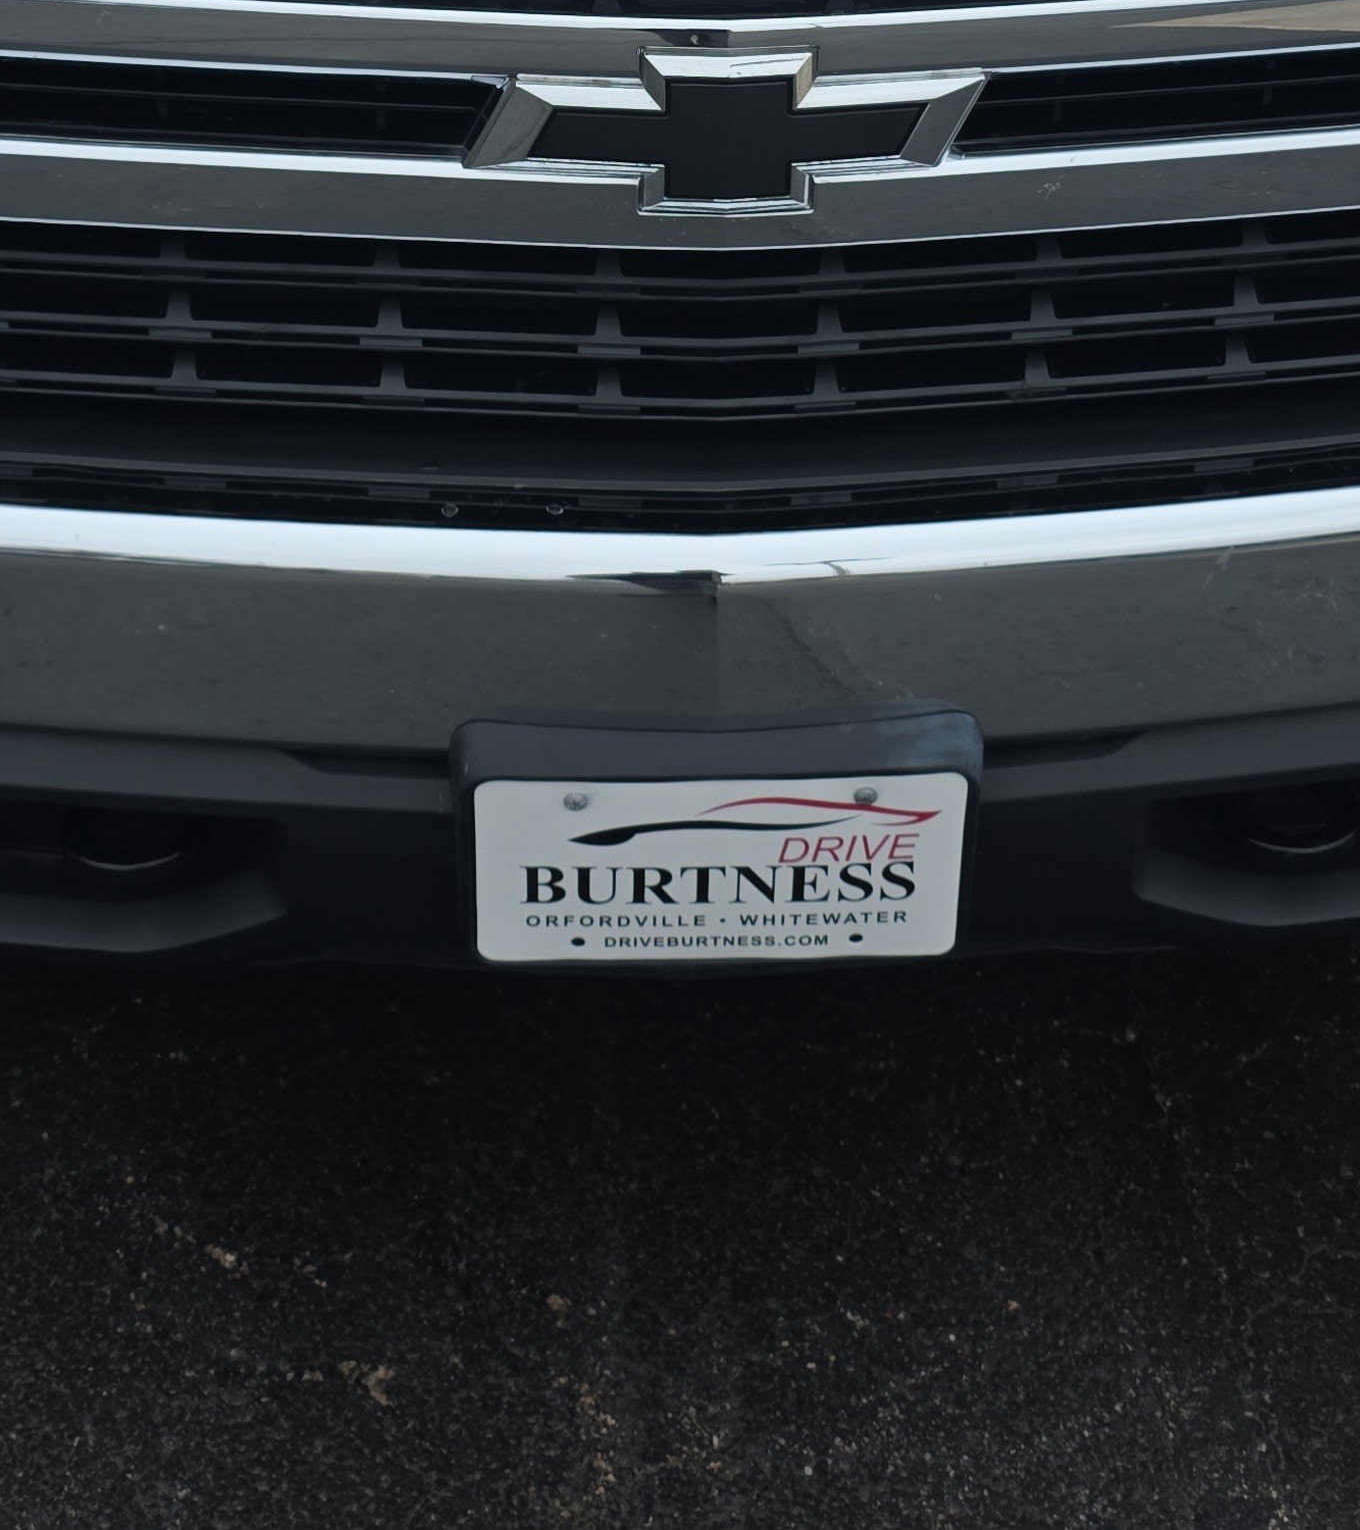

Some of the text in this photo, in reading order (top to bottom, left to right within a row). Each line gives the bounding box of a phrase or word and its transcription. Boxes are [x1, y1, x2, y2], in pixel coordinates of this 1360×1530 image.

[778, 832, 920, 864] DRIVE
[518, 861, 917, 905] BURTNESS
[525, 910, 908, 929] ORFORDVILLE WHITEWATER
[603, 934, 830, 948] DRIVEBURTNESS.COM
